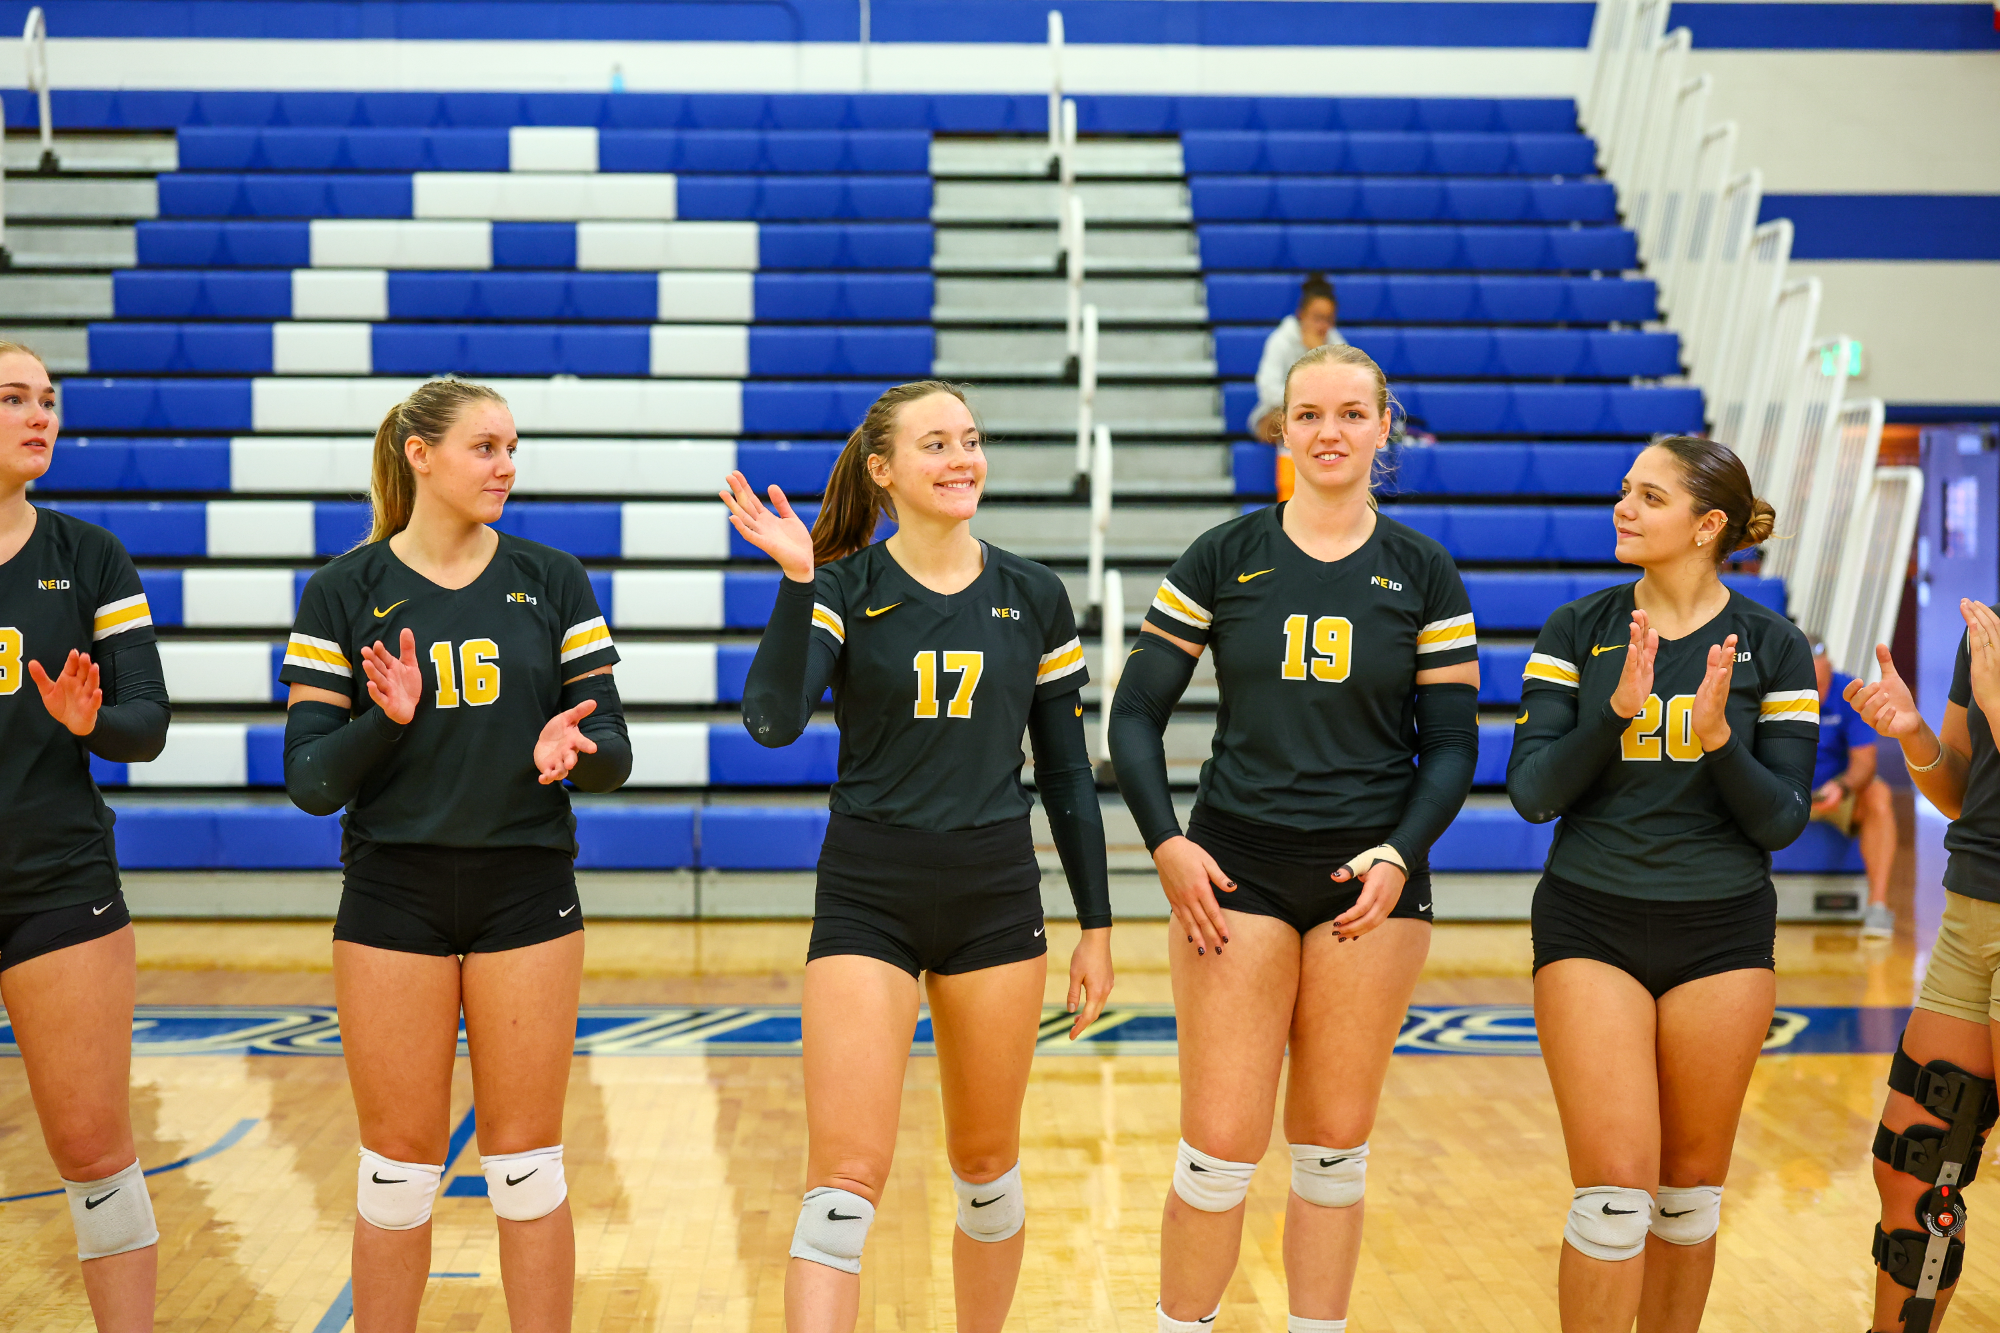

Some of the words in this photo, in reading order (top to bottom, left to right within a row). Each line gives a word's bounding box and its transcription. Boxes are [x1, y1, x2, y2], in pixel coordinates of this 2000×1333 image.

[37, 579, 70, 590] NE10
[991, 606, 1020, 620] NE10
[1371, 575, 1402, 591] NE10
[429, 637, 500, 709] 16
[1281, 613, 1353, 683] 19
[913, 650, 984, 719] 17
[1620, 693, 1705, 762] 20
